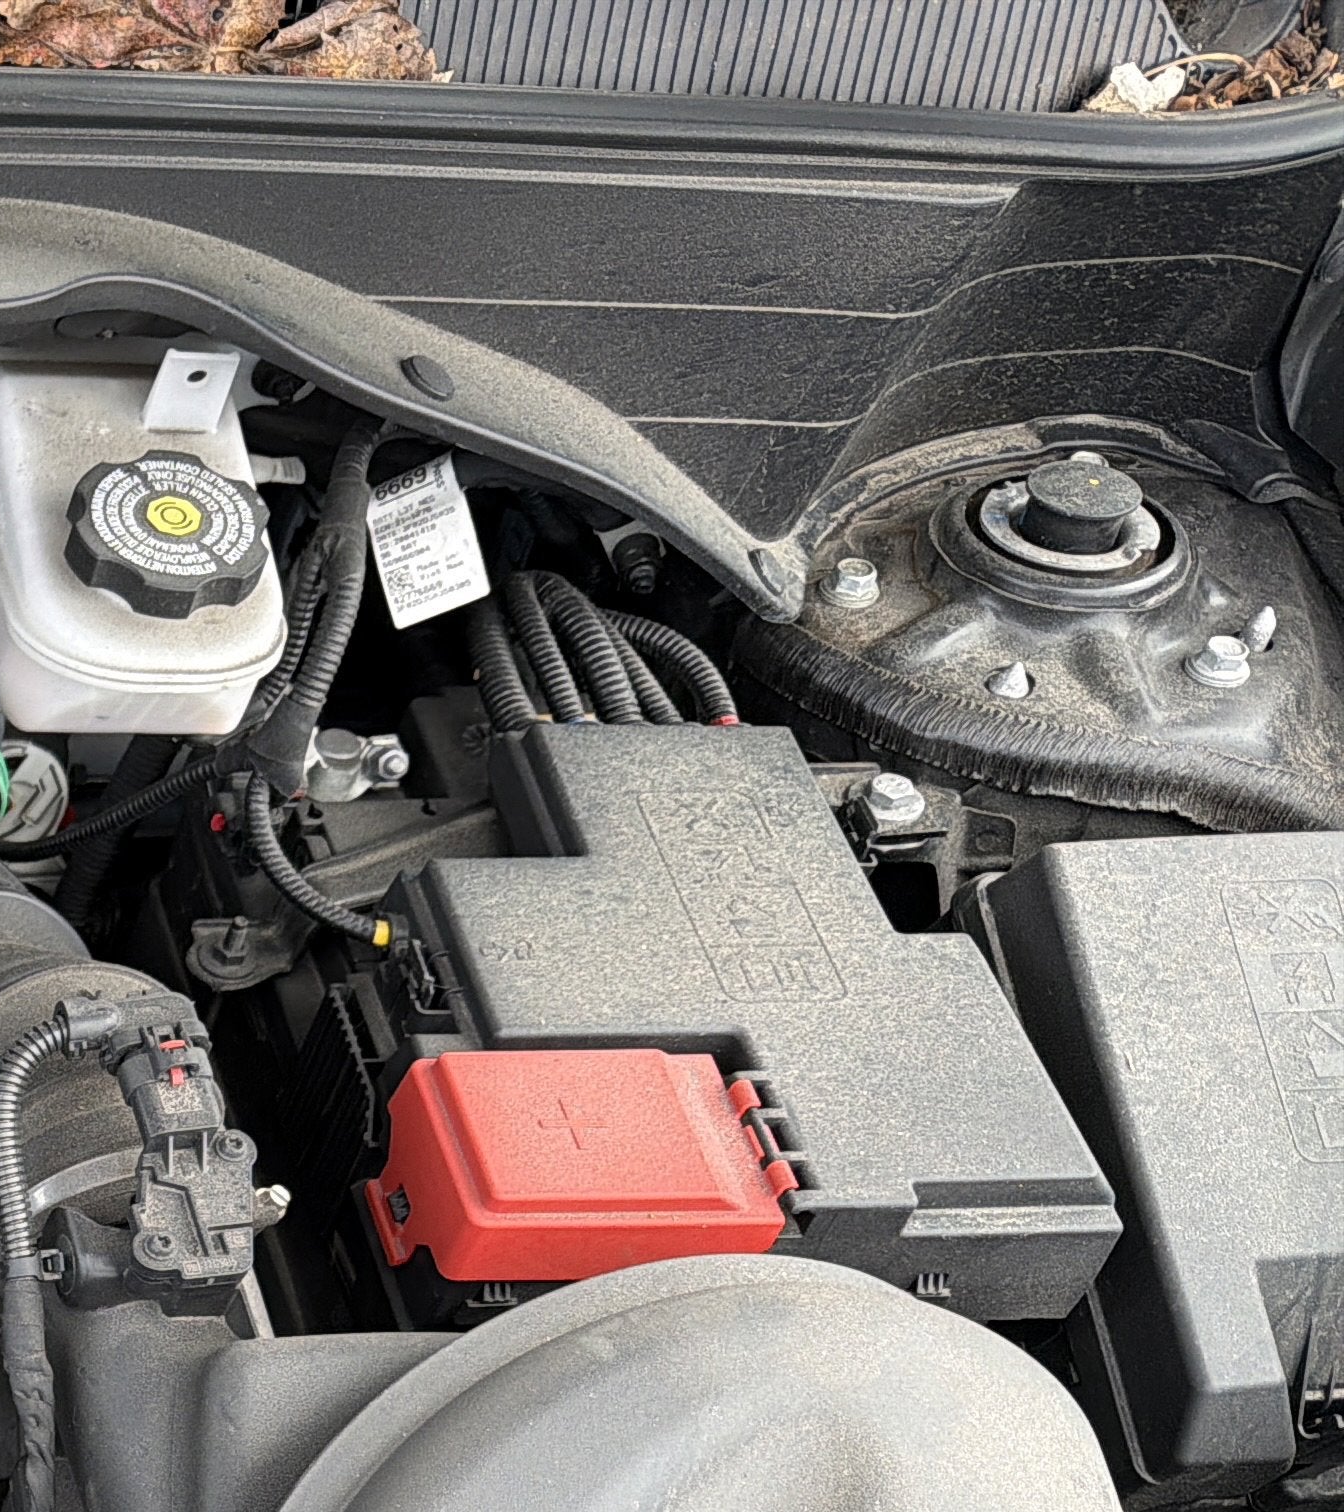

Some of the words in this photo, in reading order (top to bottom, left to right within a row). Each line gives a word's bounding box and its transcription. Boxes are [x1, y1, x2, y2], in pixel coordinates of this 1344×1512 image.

[151, 480, 190, 494] FILLER
[175, 472, 196, 484] USE
[198, 470, 238, 495] SEALED
[374, 466, 427, 501] 6669
